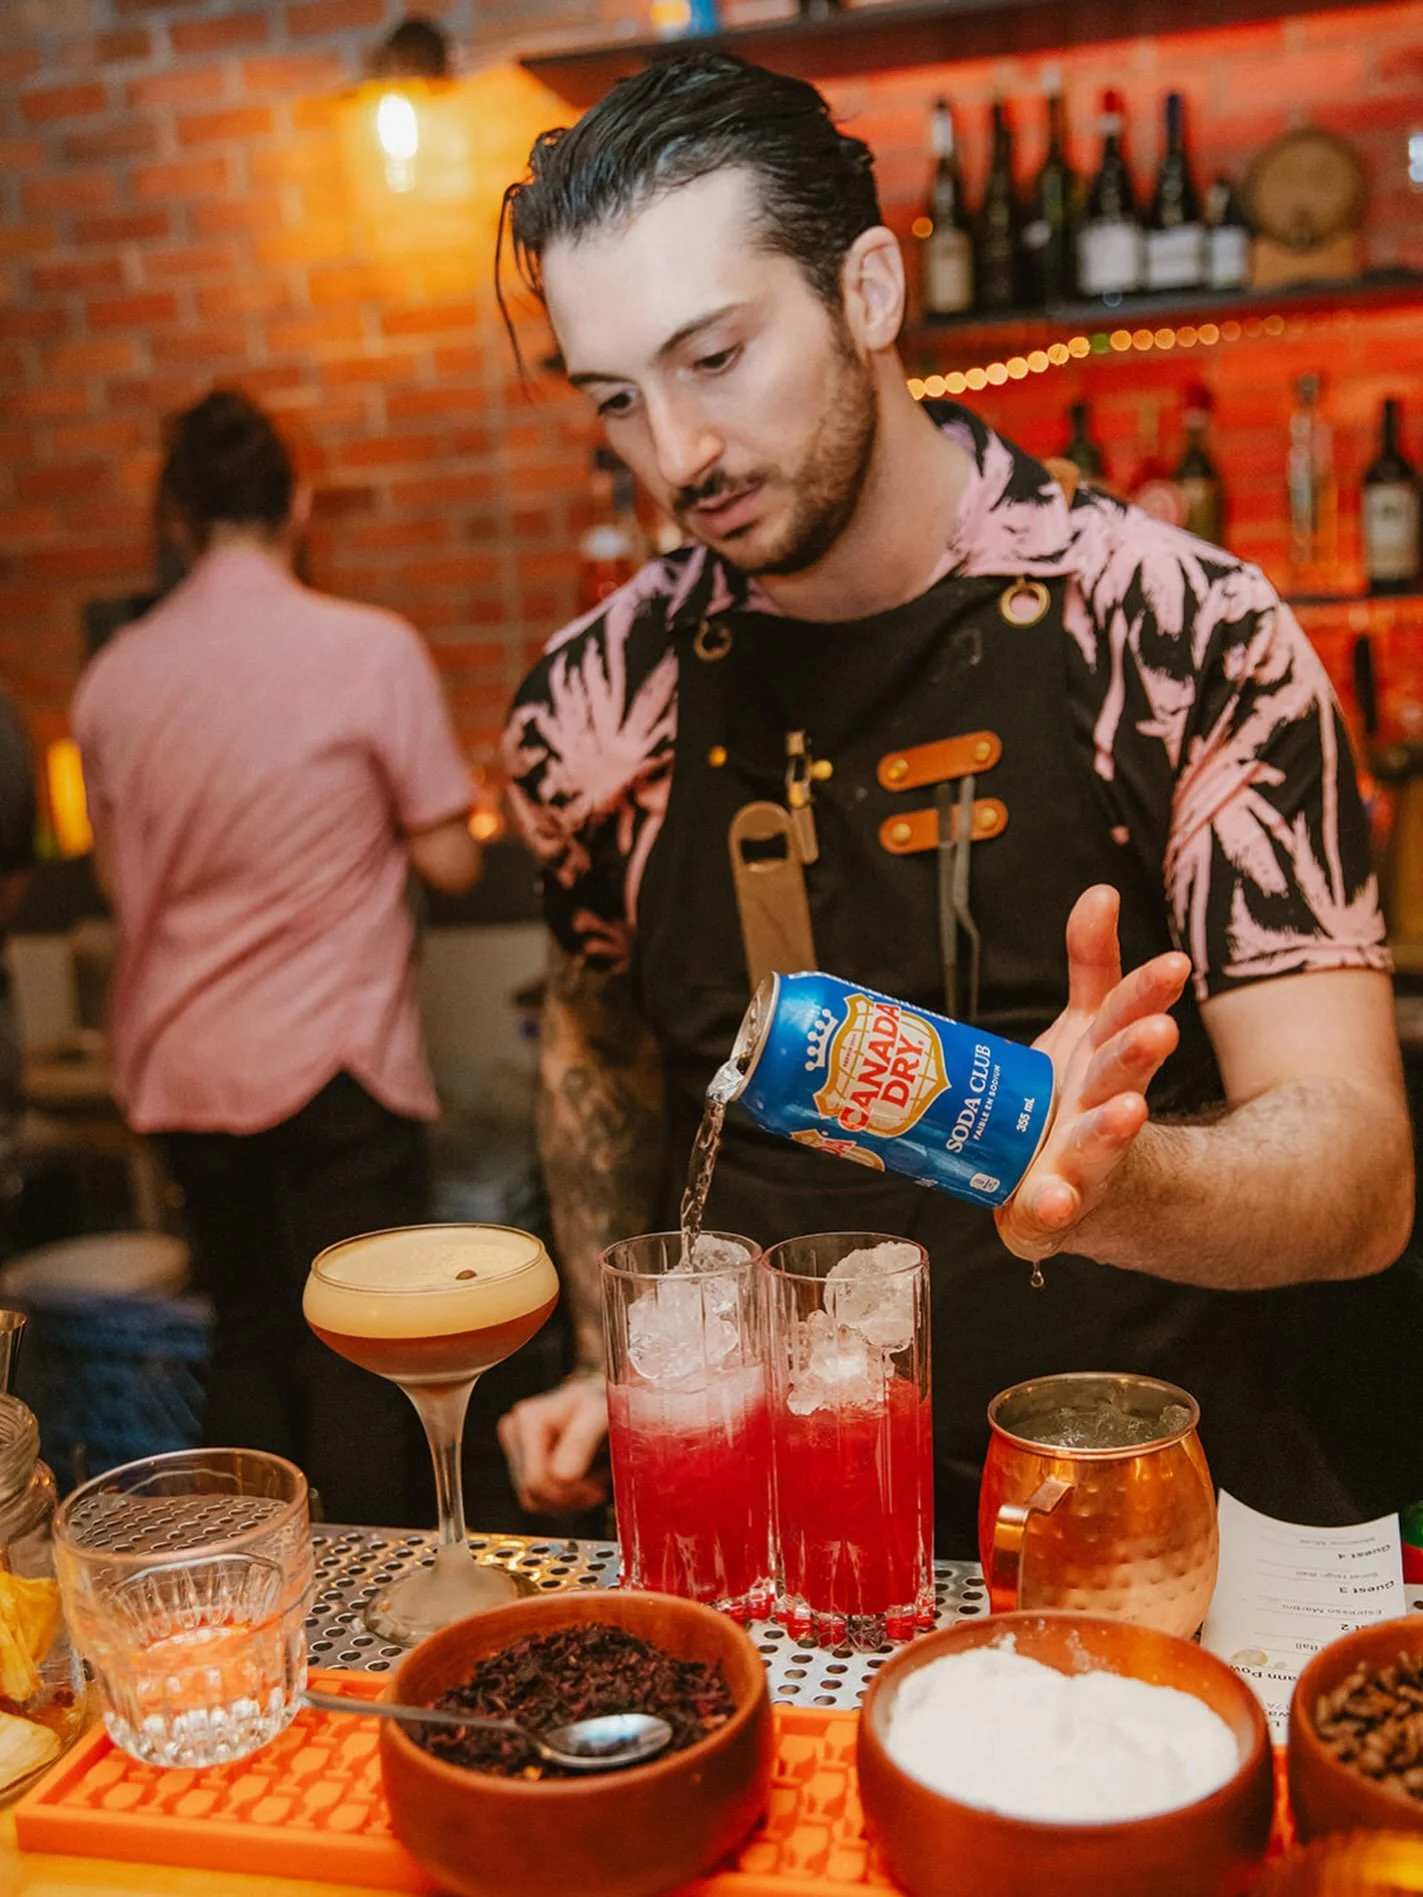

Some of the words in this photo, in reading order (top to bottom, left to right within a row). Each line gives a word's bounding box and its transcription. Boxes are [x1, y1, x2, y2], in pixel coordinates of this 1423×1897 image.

[838, 1003, 900, 1131] CANADA
[945, 1098, 982, 1154] SODA
[970, 1044, 992, 1094] CLUB
[973, 1112, 990, 1142] FAIBLE
[984, 1097, 994, 1111] EN
[1015, 1112, 1031, 1133] 355
[1350, 1543, 1391, 1559] Guest
[1353, 1579, 1395, 1594] Guest
